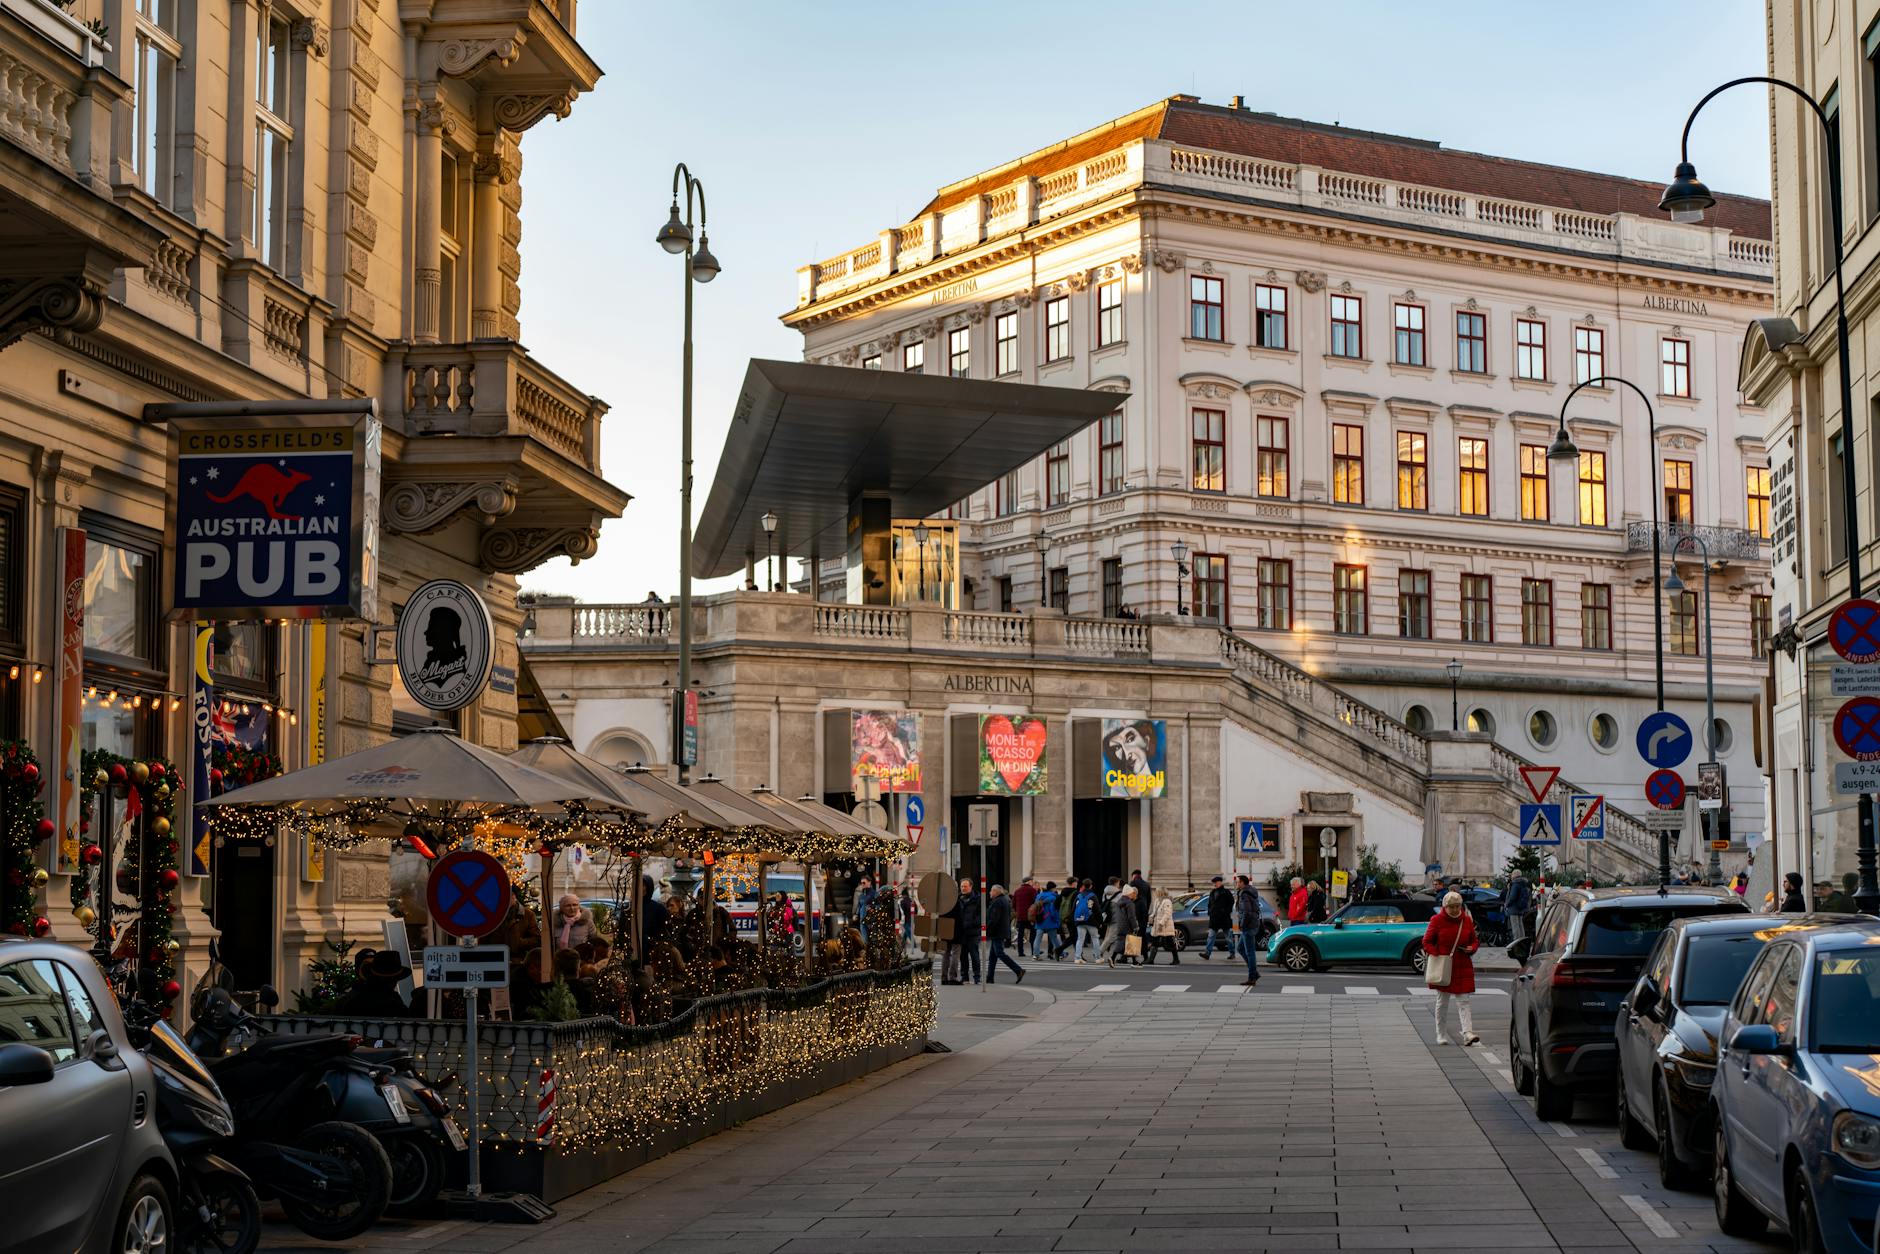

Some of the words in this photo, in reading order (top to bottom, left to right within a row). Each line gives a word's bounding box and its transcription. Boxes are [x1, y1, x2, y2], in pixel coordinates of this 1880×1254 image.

[931, 278, 978, 305] ALBERTINA
[1643, 295, 1708, 315] ALBERTINA
[189, 432, 344, 449] CROSSFIELD'S
[187, 516, 339, 537] AUSTRALIAN
[184, 539, 342, 599] PUB
[426, 589, 464, 602] CAFE
[1845, 649, 1880, 664] ANFANG
[420, 655, 465, 683] Mozart
[410, 672, 426, 693] BEI
[424, 690, 445, 701] DER
[447, 673, 473, 699] OPER
[943, 675, 1034, 693] ALBERTINA
[986, 734, 1026, 747] MONET
[987, 748, 1035, 760] PICASSO
[991, 761, 1012, 773] JIM
[1013, 761, 1037, 773] DINE
[1106, 769, 1164, 793] Chagall
[1842, 779, 1879, 791] ausgen.
[1590, 817, 1599, 827] 20
[446, 952, 458, 963] ab
[468, 970, 483, 982] bis
